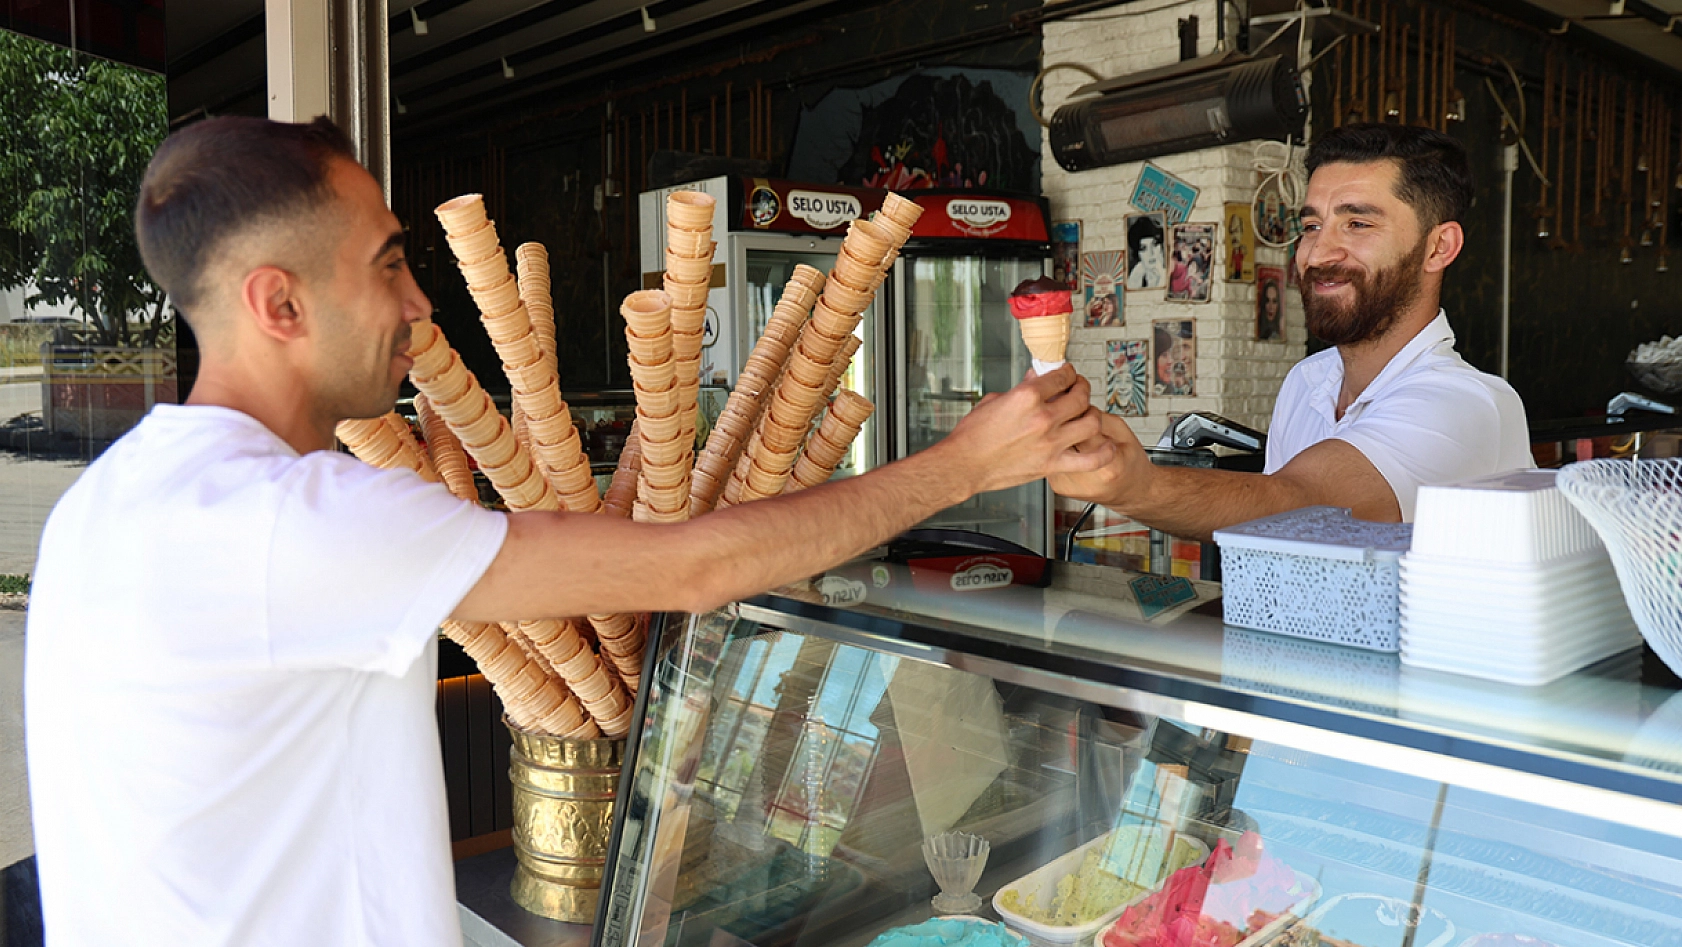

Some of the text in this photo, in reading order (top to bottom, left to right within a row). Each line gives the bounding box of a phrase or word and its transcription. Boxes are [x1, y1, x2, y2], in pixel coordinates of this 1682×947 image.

[792, 195, 856, 216] SELO USTA
[952, 203, 1007, 218] SELO USTA
